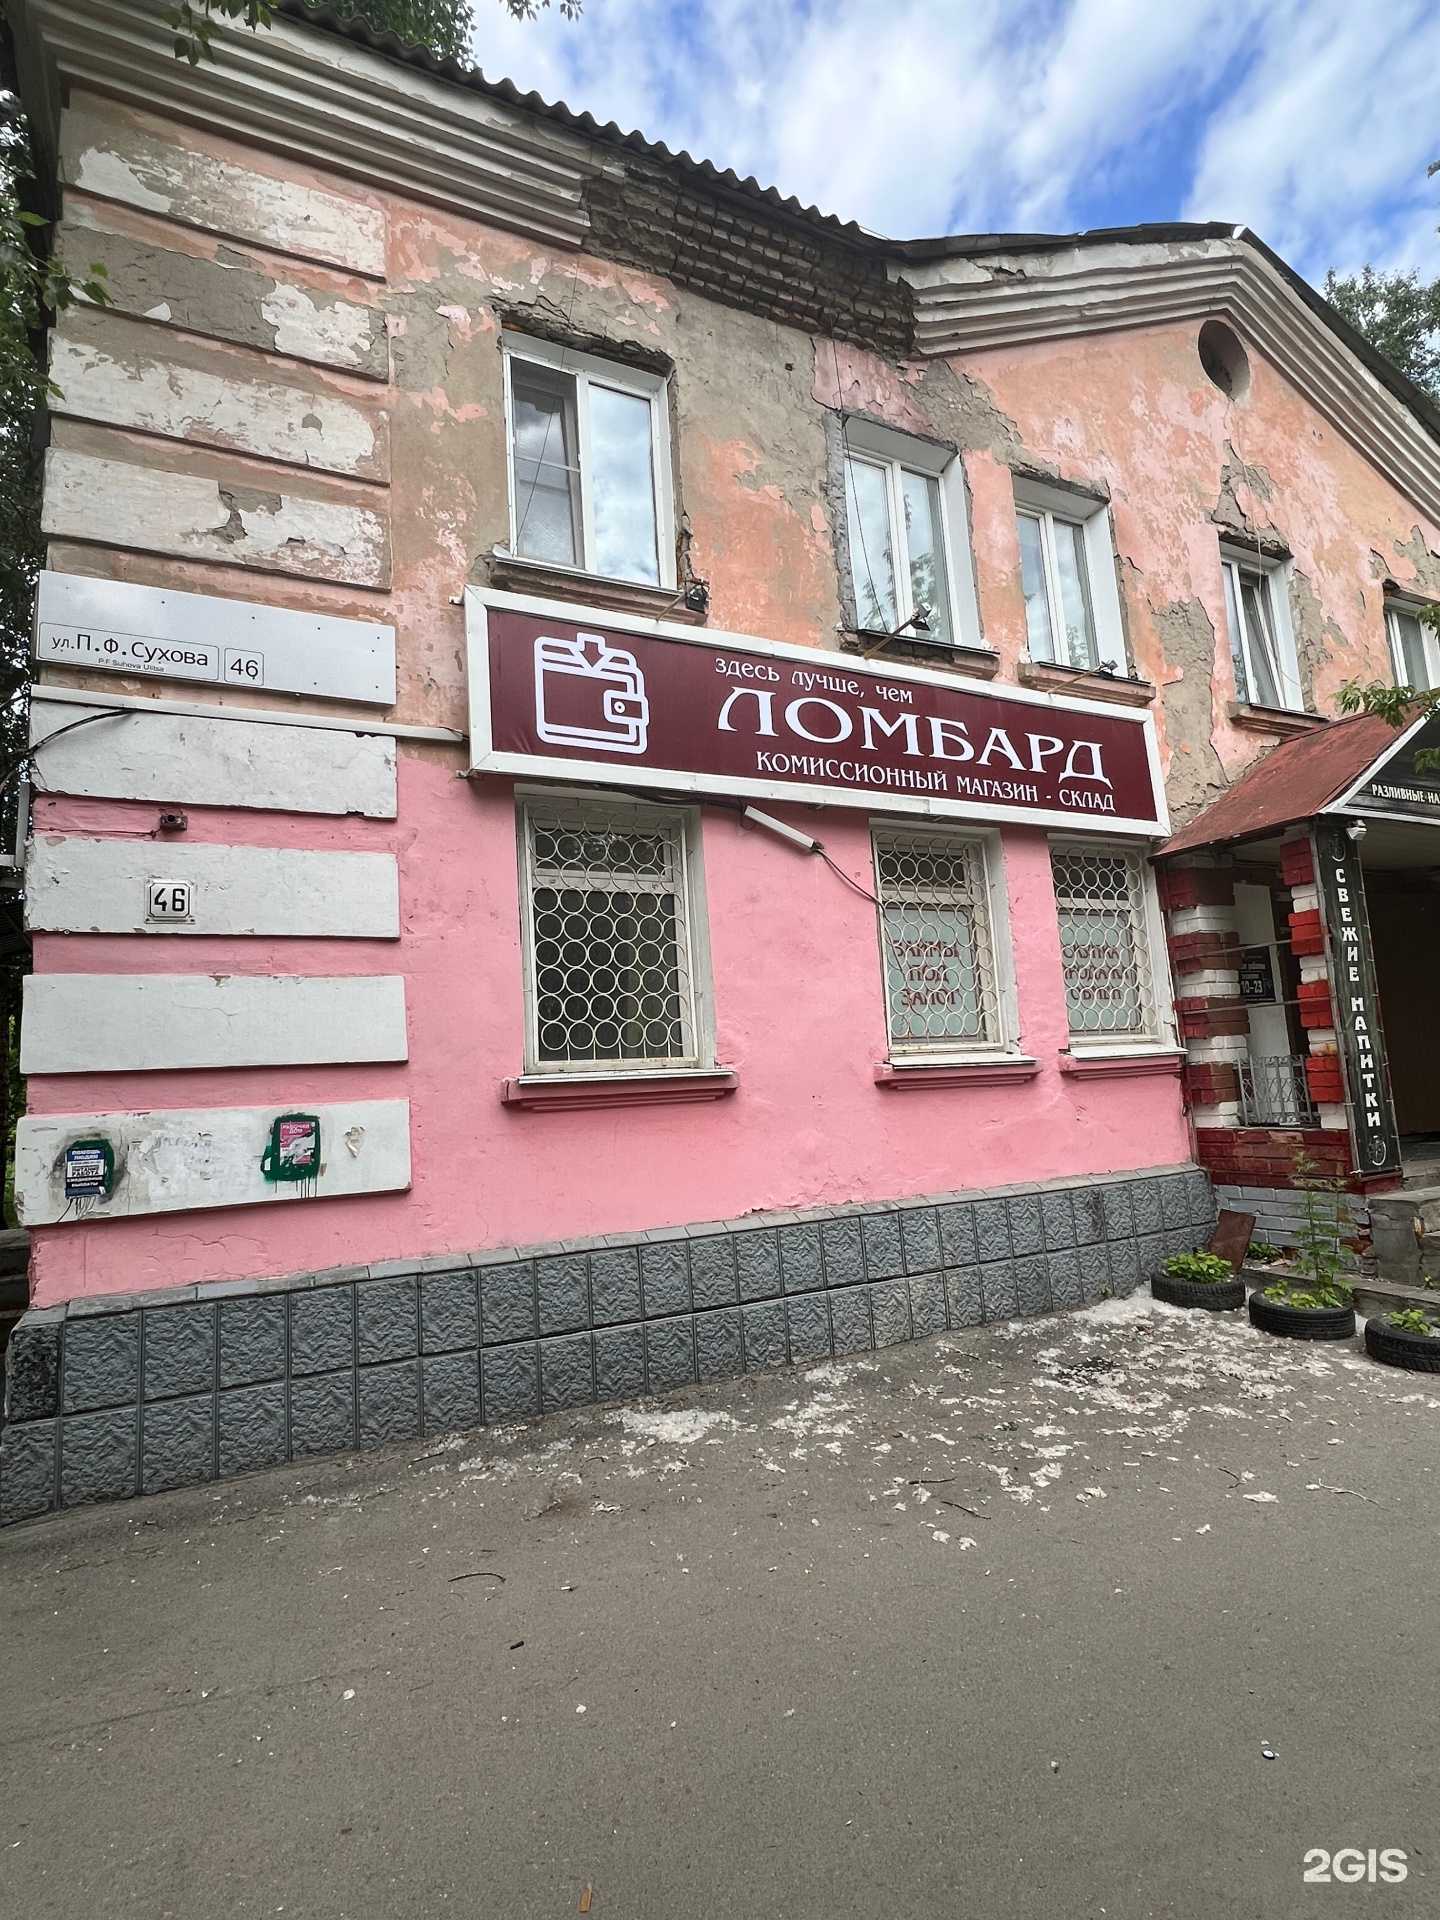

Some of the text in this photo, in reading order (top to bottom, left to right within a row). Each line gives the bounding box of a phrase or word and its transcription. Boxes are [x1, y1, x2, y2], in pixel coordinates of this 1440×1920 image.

[230, 658, 259, 679] 46
[715, 657, 913, 704] здесь лучше, чем
[717, 686, 1114, 790] ЛОМБАРД
[756, 751, 948, 791] КОМИССИОННЫЙ
[956, 775, 1039, 802] МАГАЗИН
[1058, 789, 1116, 813] СКЛАД
[1371, 784, 1440, 804] РАЗЛИВНЫЕ НА
[154, 887, 185, 912] 46
[1335, 868, 1360, 982] СВЕЖИЕ
[1351, 997, 1380, 1127] НАПИТКИ
